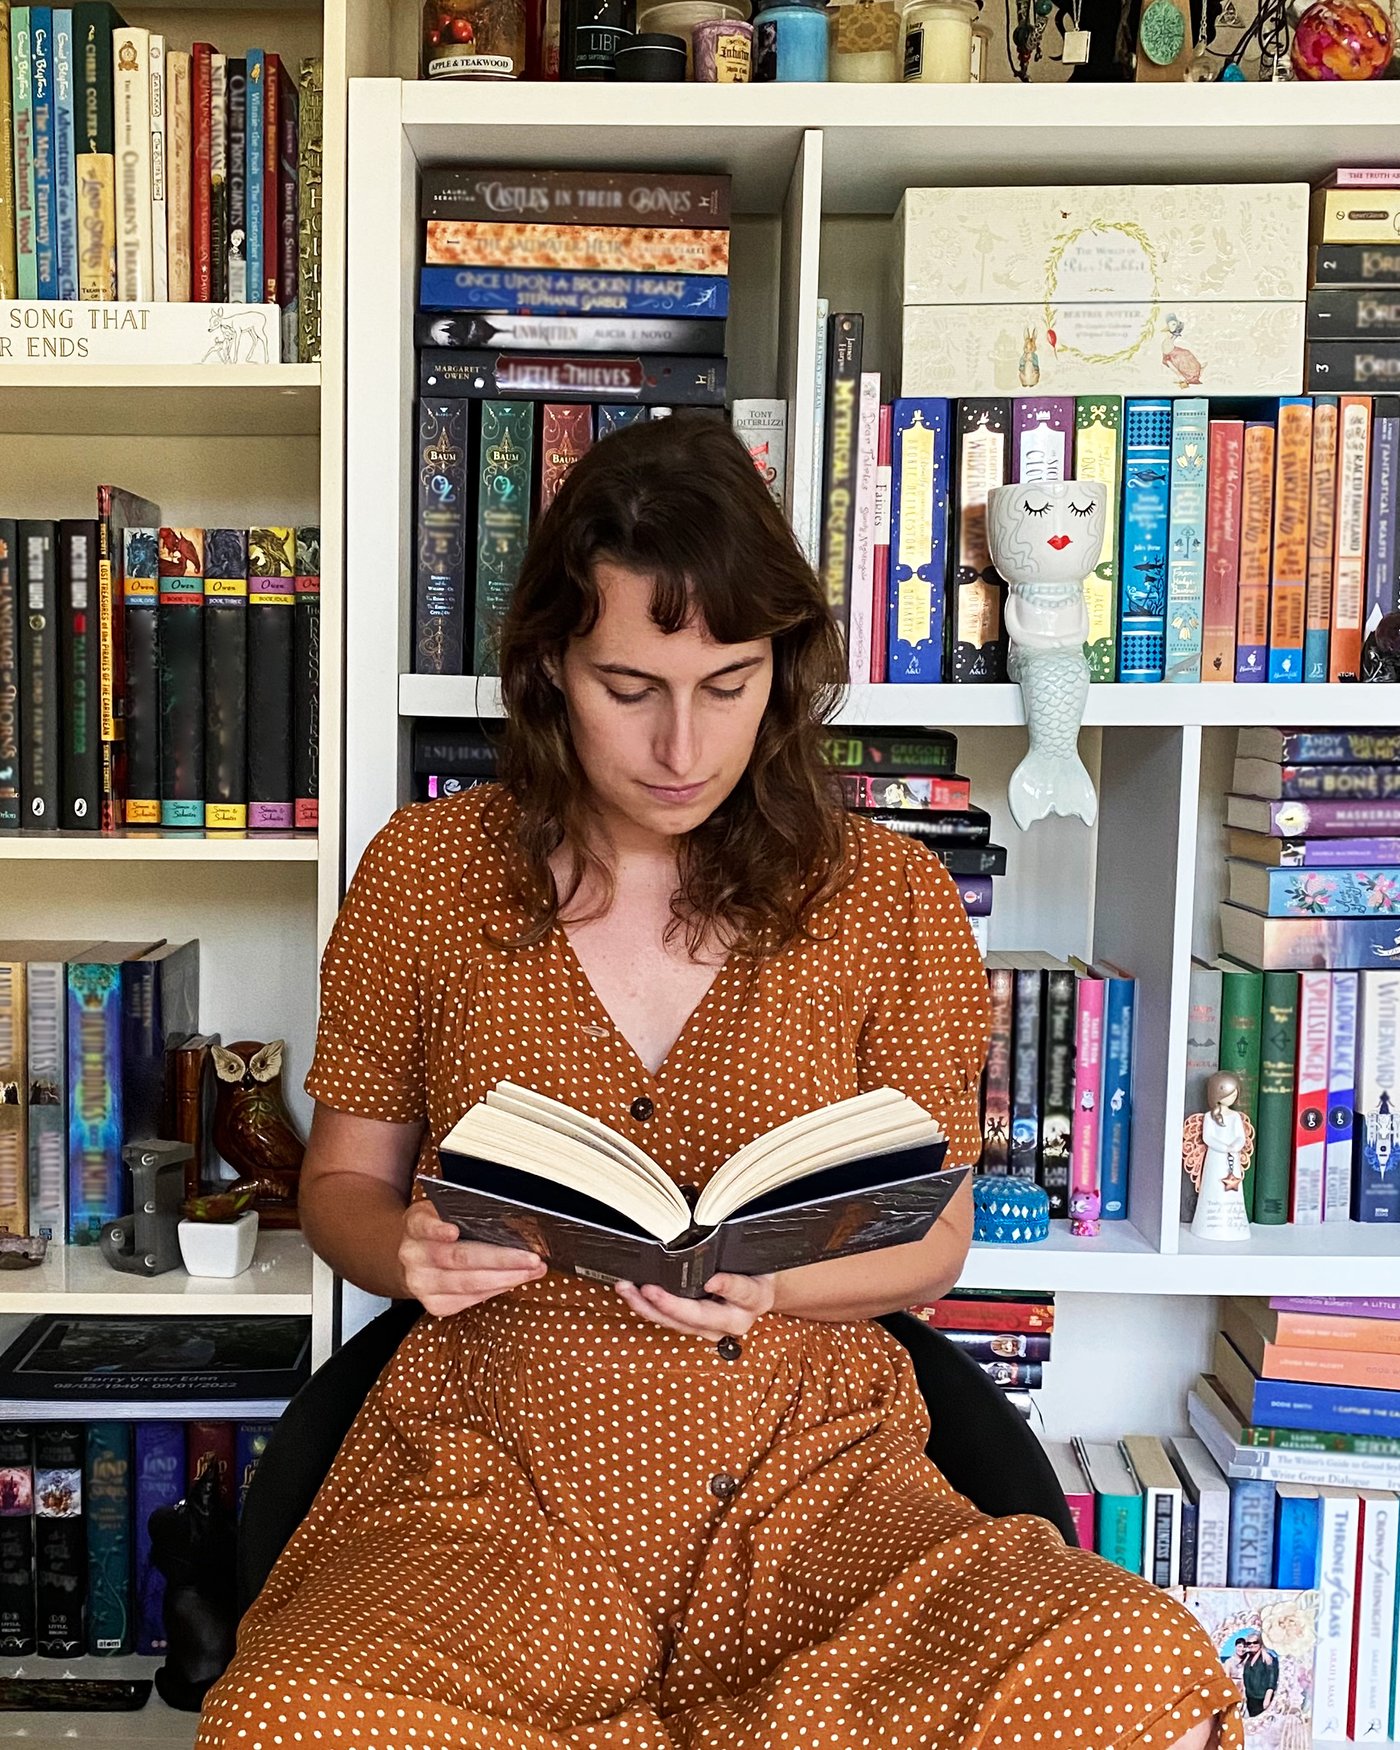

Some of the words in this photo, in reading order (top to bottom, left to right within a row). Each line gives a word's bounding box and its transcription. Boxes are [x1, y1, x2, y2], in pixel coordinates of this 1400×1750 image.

[33, 30, 46, 56] Enid
[34, 59, 47, 98] Blyton's
[86, 44, 96, 83] CHRIS
[431, 62, 451, 70] APPLE
[461, 59, 508, 69] TEAKWOOD
[211, 65, 223, 103] NEIL
[268, 75, 276, 123] LITERARY
[17, 108, 29, 135] The
[36, 104, 48, 131] The
[86, 88, 97, 137] COLFER
[58, 106, 71, 187] Adventures
[211, 106, 223, 171] GAIMAN
[250, 92, 260, 174] Winnie-the-Pooh
[268, 125, 276, 172] BESTIARY
[18, 137, 31, 210] Enchanted
[35, 136, 49, 177] Magic
[122, 151, 139, 235] CHILDREN'S
[231, 177, 244, 225] GIANTS
[251, 184, 260, 201] The
[476, 182, 549, 213] CASTLES
[555, 190, 573, 206] IN
[577, 190, 623, 207] THEIR
[629, 187, 691, 215] BONES
[37, 184, 50, 244] Faraway
[250, 203, 260, 259] Christopher
[20, 216, 32, 254] Wood
[59, 219, 73, 277] Wishing
[40, 248, 52, 282] Tree
[1323, 261, 1337, 269] 2
[267, 278, 276, 293] BY
[455, 272, 501, 288] ONCE
[505, 274, 552, 293] UPON
[572, 276, 631, 294] BROKEN
[635, 279, 686, 299] HEART
[516, 292, 578, 305] STEPHANIE
[581, 296, 627, 310] GARBER
[10, 308, 74, 329] SONG
[88, 309, 150, 330] THAT
[641, 330, 672, 340] NOVO
[27, 337, 89, 358] ENDS
[434, 364, 480, 373] MARGARET
[444, 372, 470, 380] OWEN
[509, 363, 560, 384] LITTLE
[565, 363, 631, 385] THIEVES
[1316, 363, 1329, 373] 3
[831, 379, 855, 485] MYTHICAL
[861, 412, 875, 445] Dear
[430, 451, 456, 460] BAUM
[493, 451, 519, 460] BAUM
[1353, 454, 1363, 491] RACED
[1280, 450, 1297, 535] FAIRYLAND
[1380, 443, 1392, 515] FANTASTICAL
[875, 484, 888, 527] Fairies
[1245, 469, 1262, 543] FAIRYLAND
[1312, 468, 1334, 550] FAIRYLAND
[1350, 493, 1362, 552] FAIRYLAND
[71, 535, 88, 579] DOCTOR
[826, 488, 852, 607] CREATURES
[1378, 520, 1389, 559] BEASTS
[28, 536, 44, 580] DOCTOR
[100, 564, 110, 583] LOST
[28, 582, 44, 610] WHO
[71, 581, 88, 609] WHO
[132, 581, 155, 591] Owen
[171, 579, 195, 589] Owen
[213, 582, 236, 591] Owen
[261, 579, 284, 589] Owen
[100, 585, 110, 620] TREASURES
[101, 621, 110, 630] of
[101, 631, 110, 642] the
[101, 643, 110, 671] PIRATES
[74, 679, 86, 699] OF
[101, 673, 111, 684] OF
[102, 684, 111, 697] THE
[73, 702, 86, 754] TERROR
[102, 697, 112, 736] CARIBBEAN
[1300, 747, 1343, 758] SAGAR
[1305, 736, 1341, 746] ANDY
[1298, 777, 1318, 788] THE
[1324, 775, 1377, 791] BONE
[31, 970, 56, 1009] DAVID
[992, 1004, 1006, 1035] Wolf
[1302, 978, 1327, 1082] SPELLSLINGER
[1332, 976, 1355, 1079] SHADOWBLACK
[1375, 981, 1399, 1090] WITHERWARD
[31, 1016, 57, 1073] EDDINGS
[990, 1040, 1005, 1079] Notes
[1018, 1048, 1035, 1104] Singing
[1051, 1047, 1067, 1106] Running
[82, 1376, 124, 1384] Barry
[1271, 1400, 1291, 1409] DODIE
[1293, 1402, 1312, 1410] SMITH
[1338, 1406, 1371, 1415] CAPTURE
[1373, 1408, 1387, 1416] THE
[1270, 1470, 1295, 1481] Write
[1299, 1471, 1325, 1483] Great
[1328, 1473, 1370, 1489] Dialogue
[1278, 1455, 1292, 1463] The
[1327, 1458, 1349, 1468] Guide
[1362, 1461, 1384, 1470] Good
[1157, 1516, 1171, 1559] PRINCESS
[1332, 1511, 1349, 1574] THRONE
[1375, 1511, 1387, 1558] CROWN
[1329, 1592, 1344, 1637] GLASS
[1371, 1573, 1383, 1638] MIDNIGHT
[97, 1639, 121, 1648] atom
